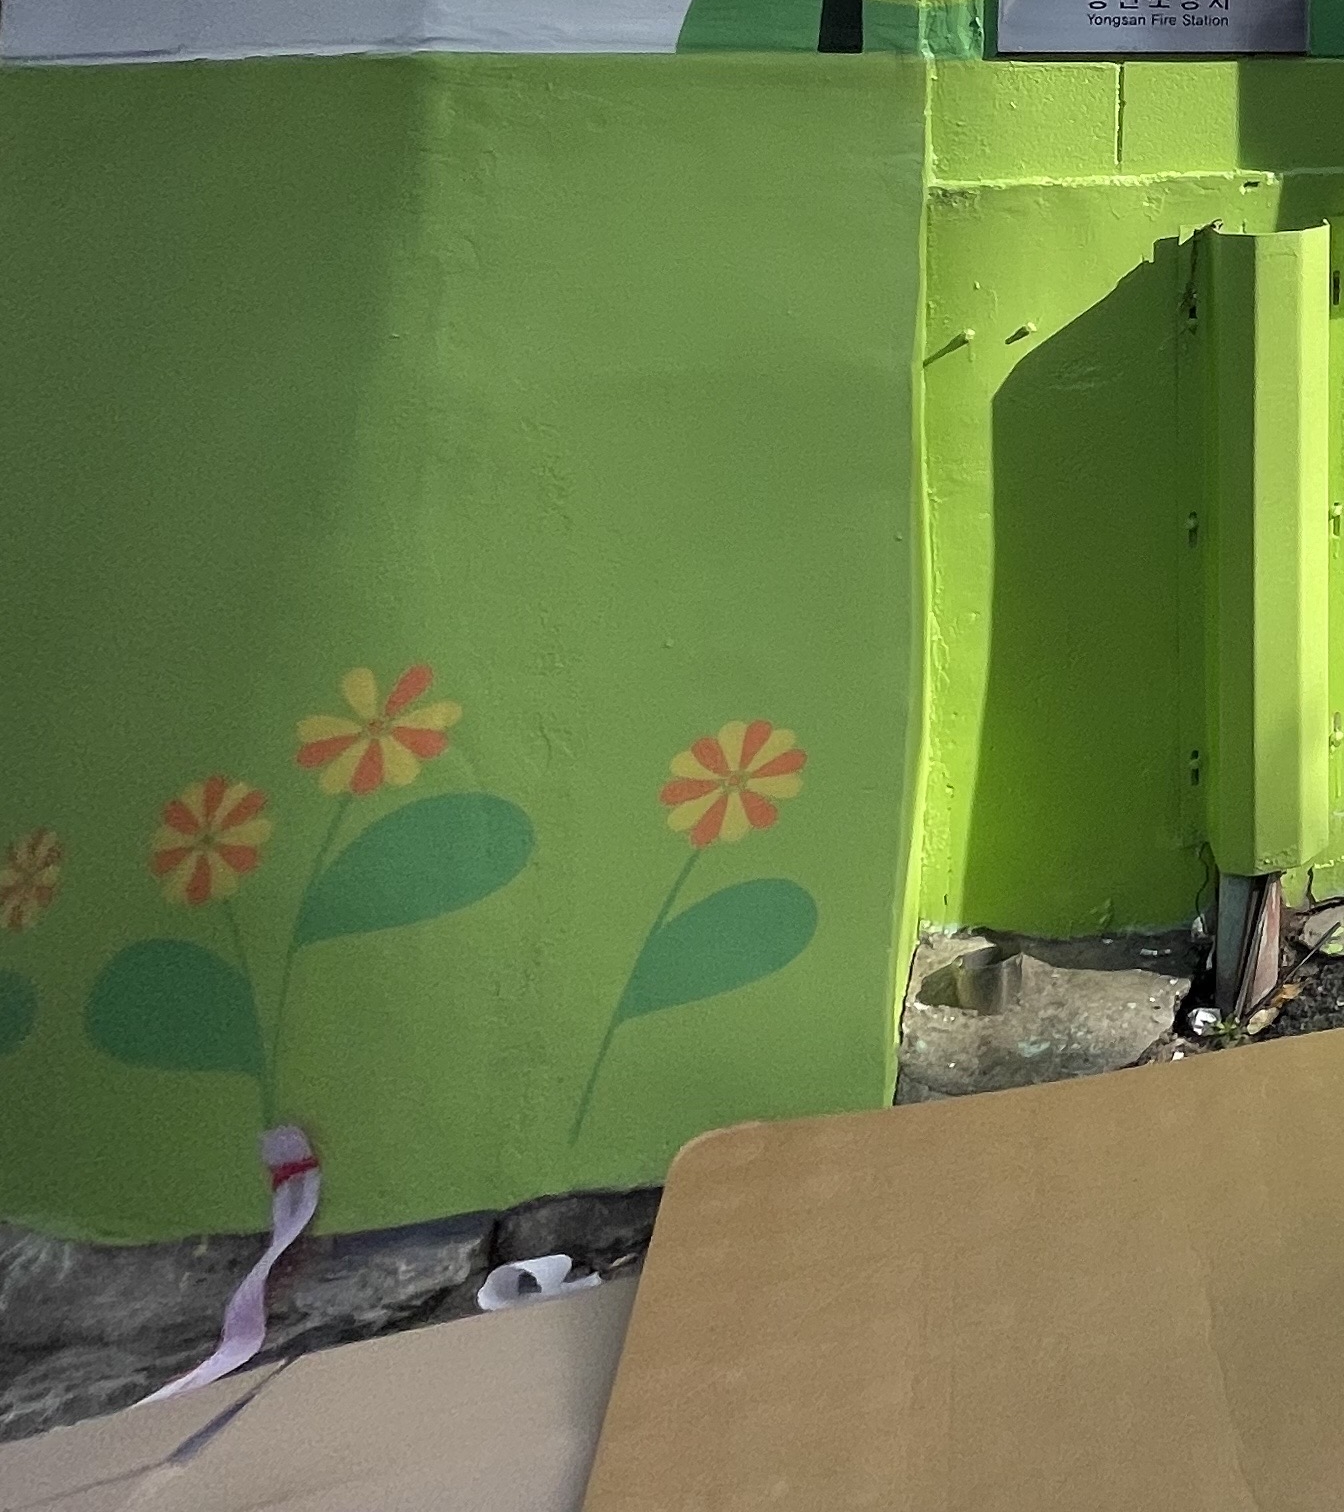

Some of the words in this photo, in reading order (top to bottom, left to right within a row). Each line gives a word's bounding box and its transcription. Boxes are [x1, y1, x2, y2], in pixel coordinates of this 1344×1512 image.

[1087, 13, 1146, 28] Yongsan
[1151, 13, 1177, 26] Fire
[1182, 13, 1229, 27] Station
